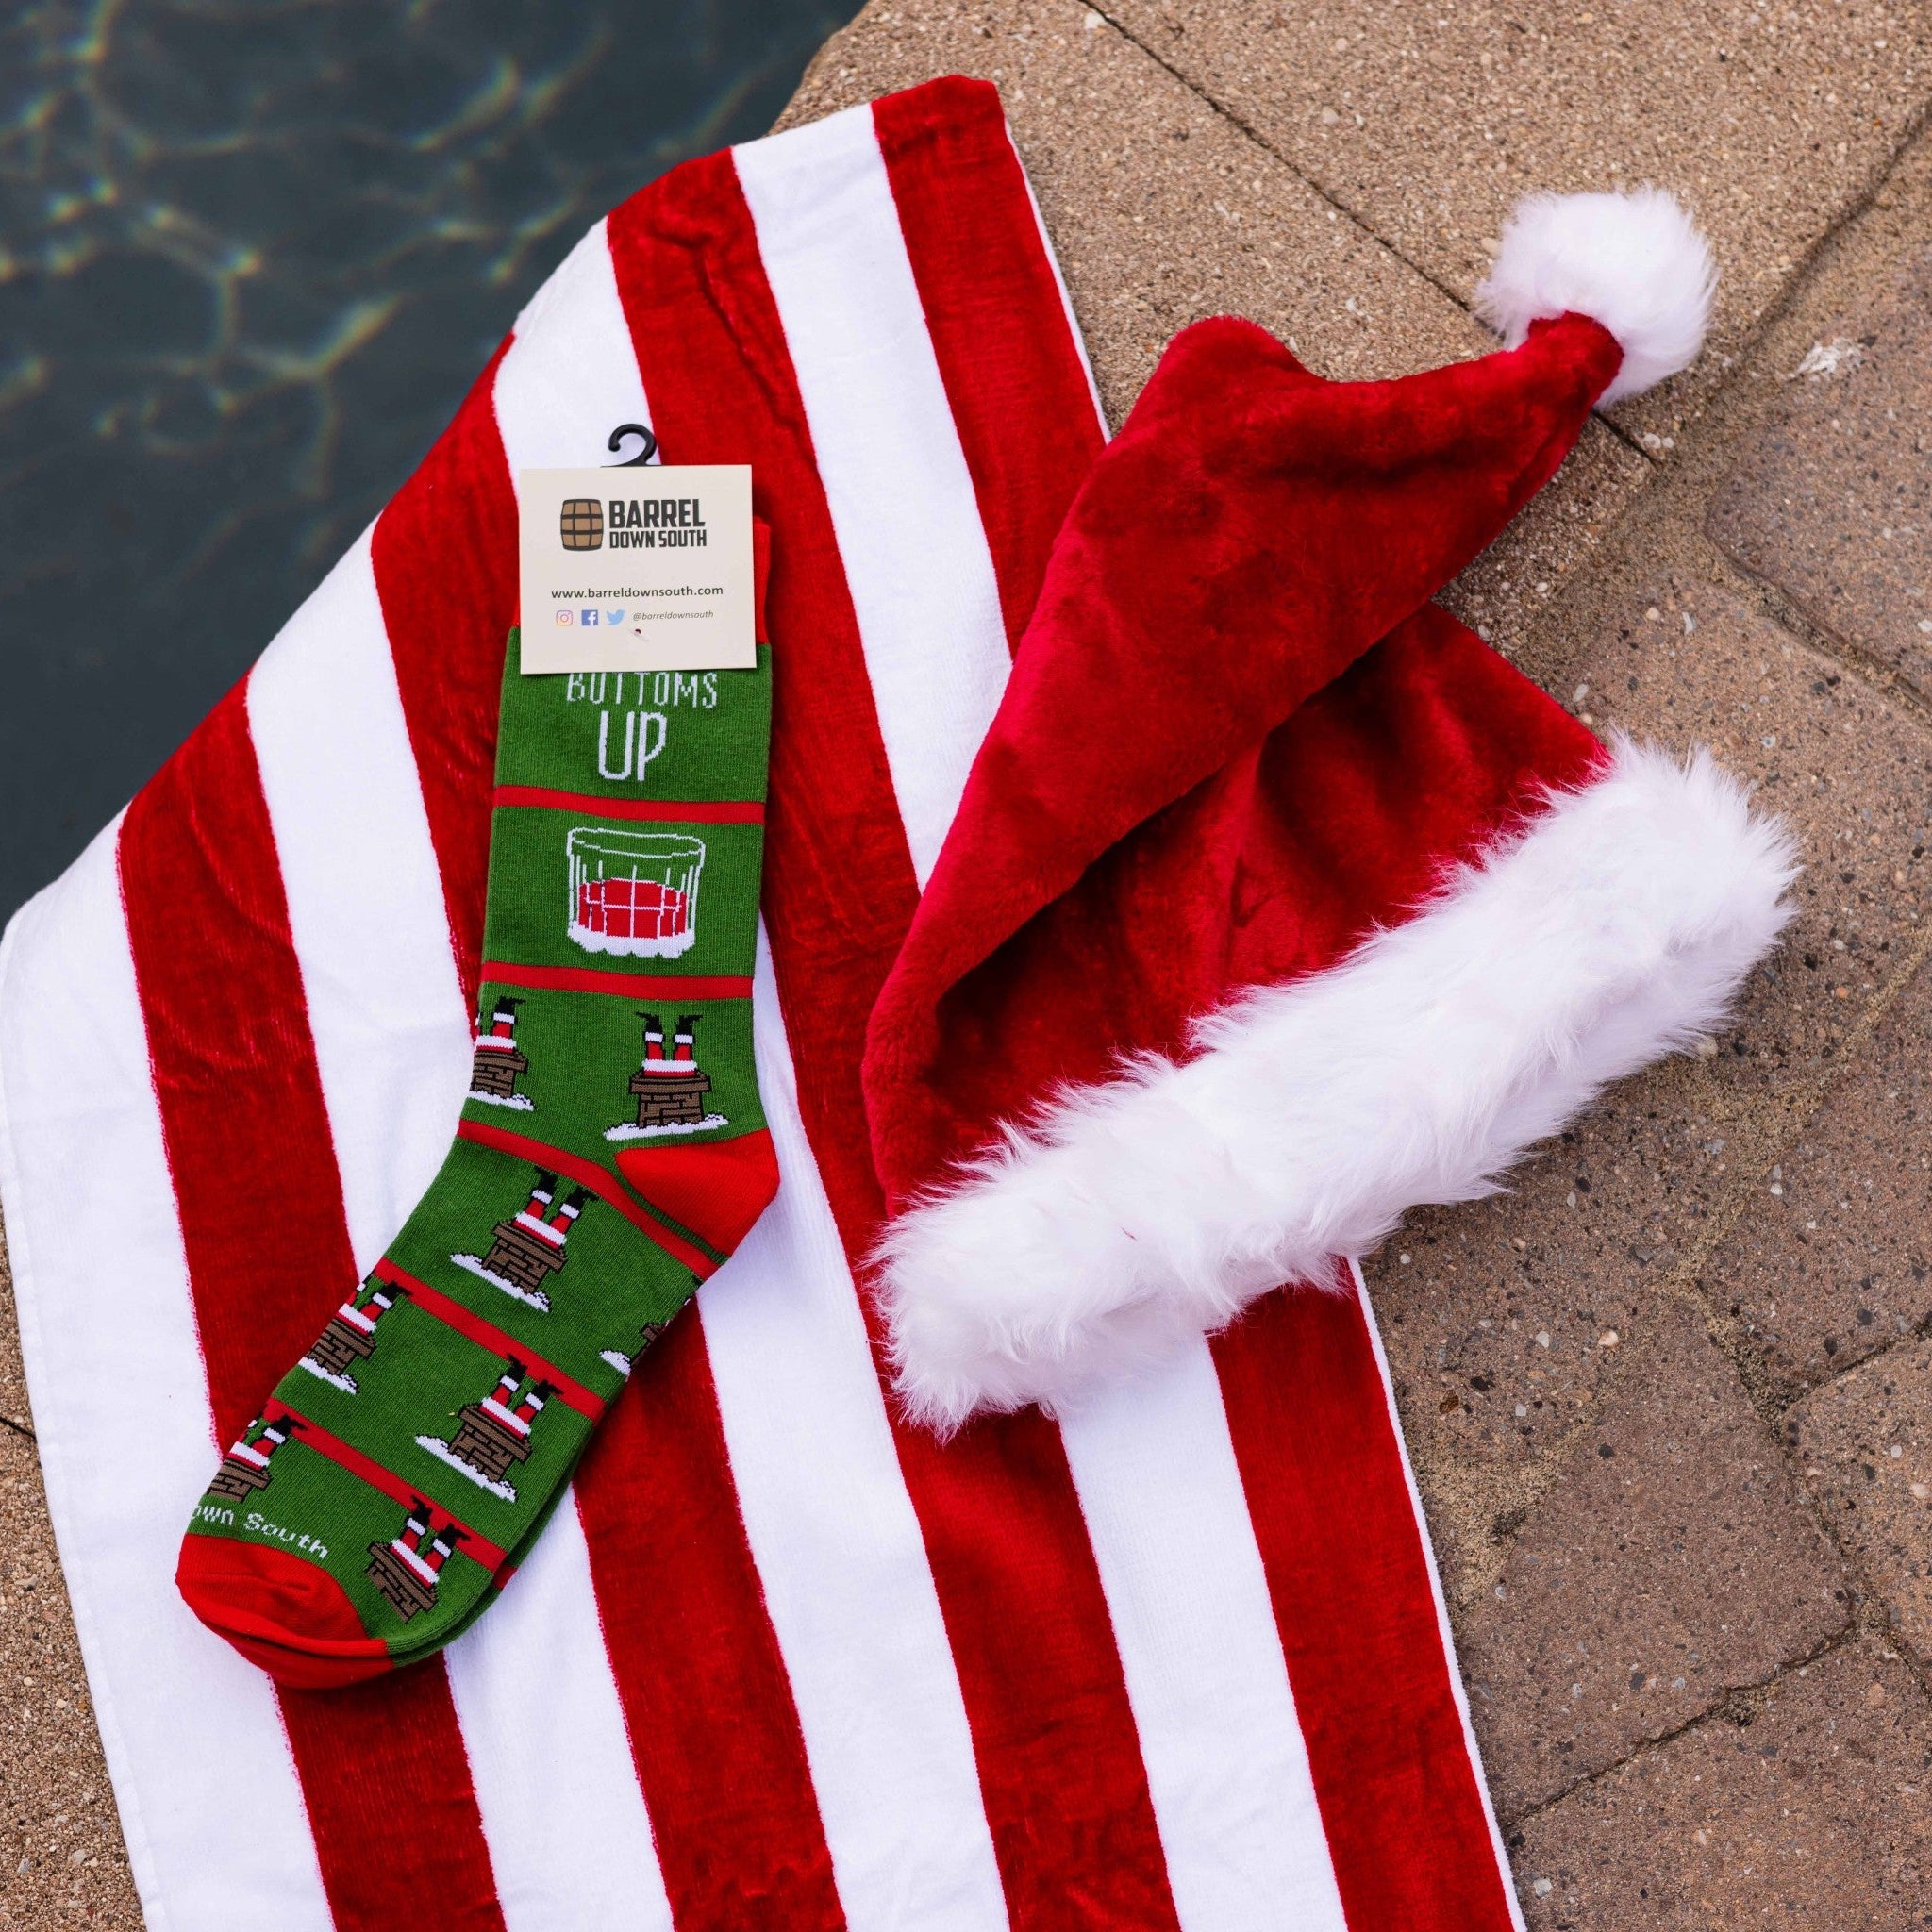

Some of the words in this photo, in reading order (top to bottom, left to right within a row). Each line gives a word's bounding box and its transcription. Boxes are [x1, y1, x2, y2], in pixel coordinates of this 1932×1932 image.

[608, 498, 706, 528] BARREL
[608, 531, 655, 548] DOWN
[658, 529, 707, 548] SOUTH
[551, 586, 724, 599] www.barreldownsouth.com
[632, 609, 714, 621] @barreldownsouth
[598, 710, 667, 781] UP
[243, 1512, 329, 1559] South
